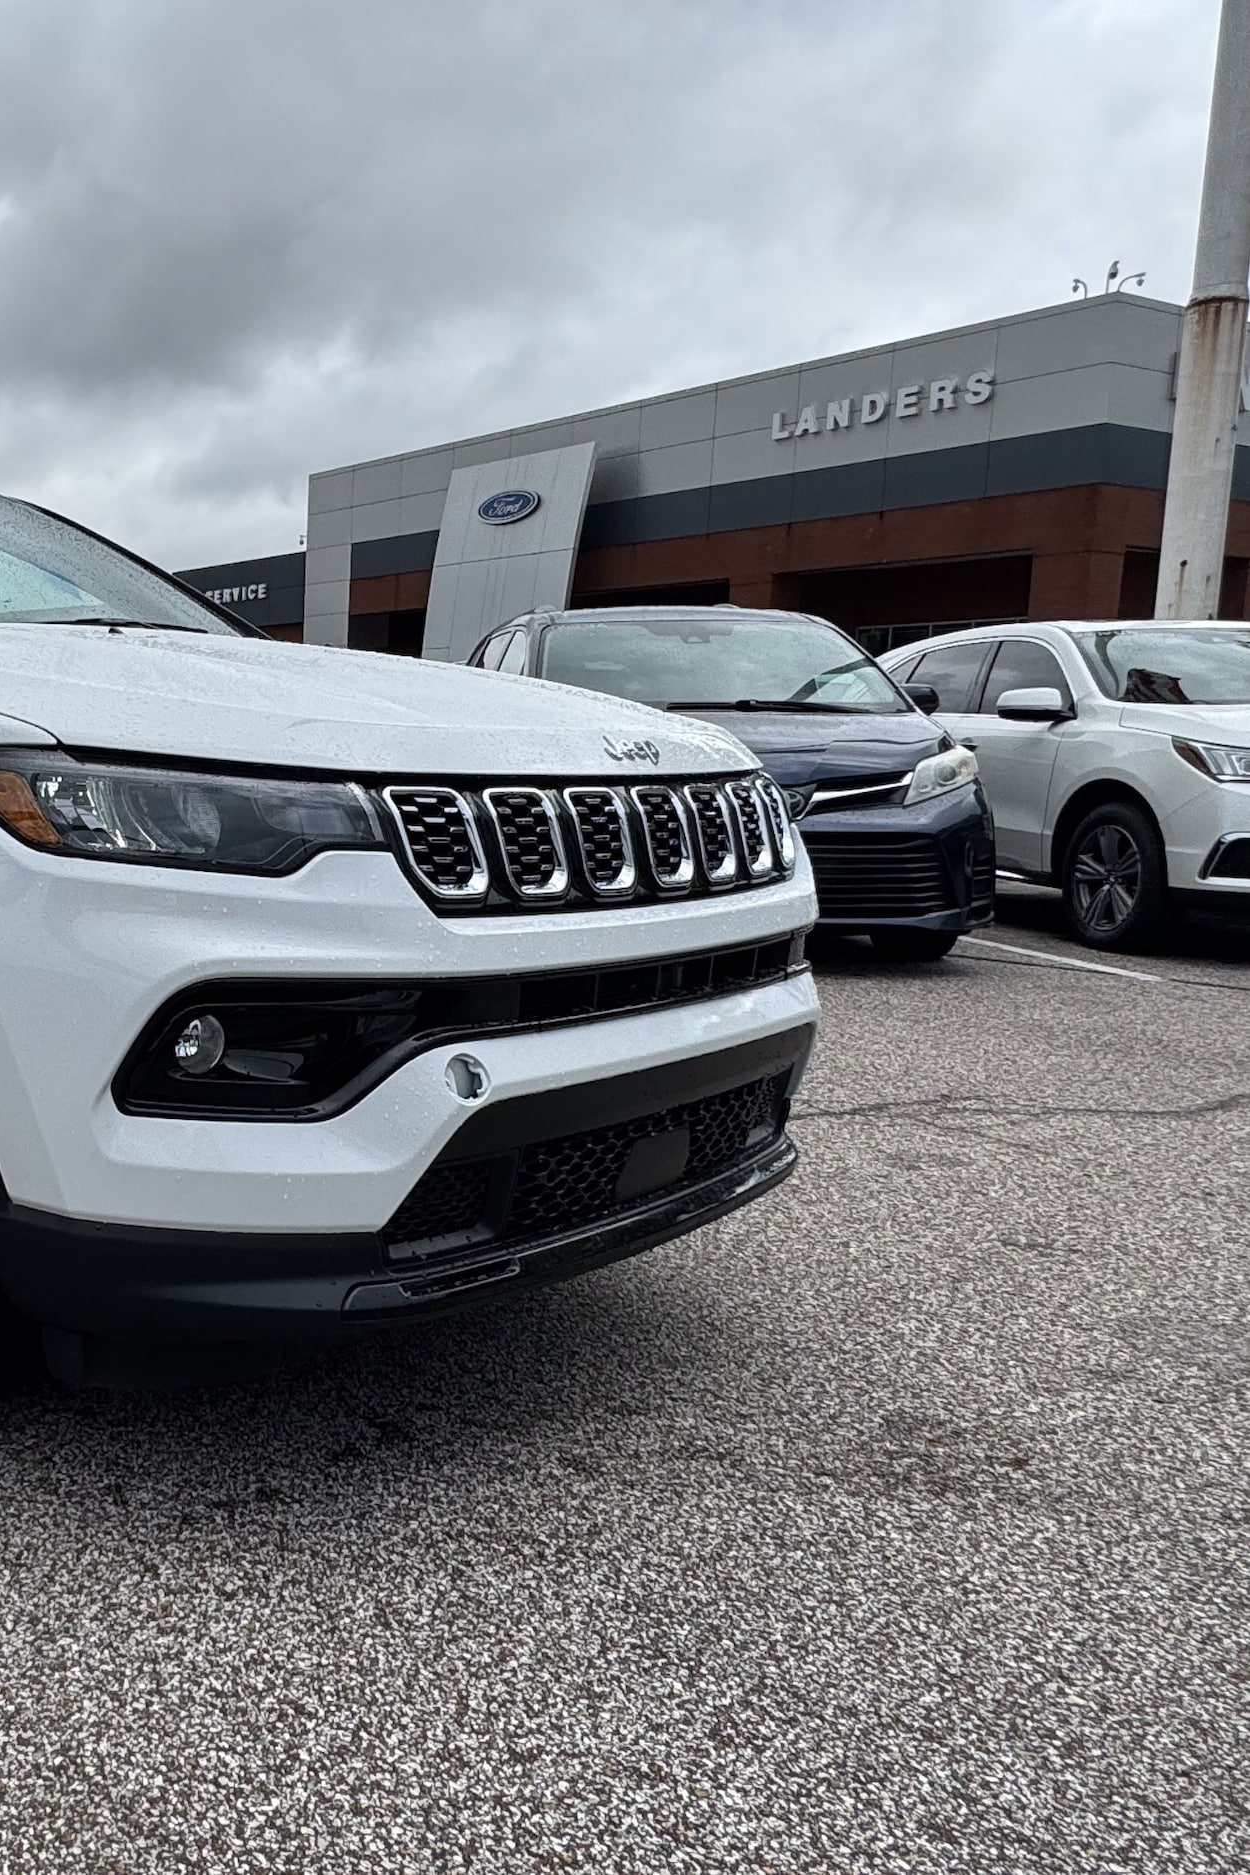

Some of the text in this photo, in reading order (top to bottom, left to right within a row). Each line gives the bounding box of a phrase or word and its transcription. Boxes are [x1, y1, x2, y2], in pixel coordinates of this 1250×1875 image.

[771, 370, 995, 441] LANDERS
[489, 496, 524, 516] Ford
[205, 583, 268, 604] SERVICE
[602, 735, 660, 766] Jeep
